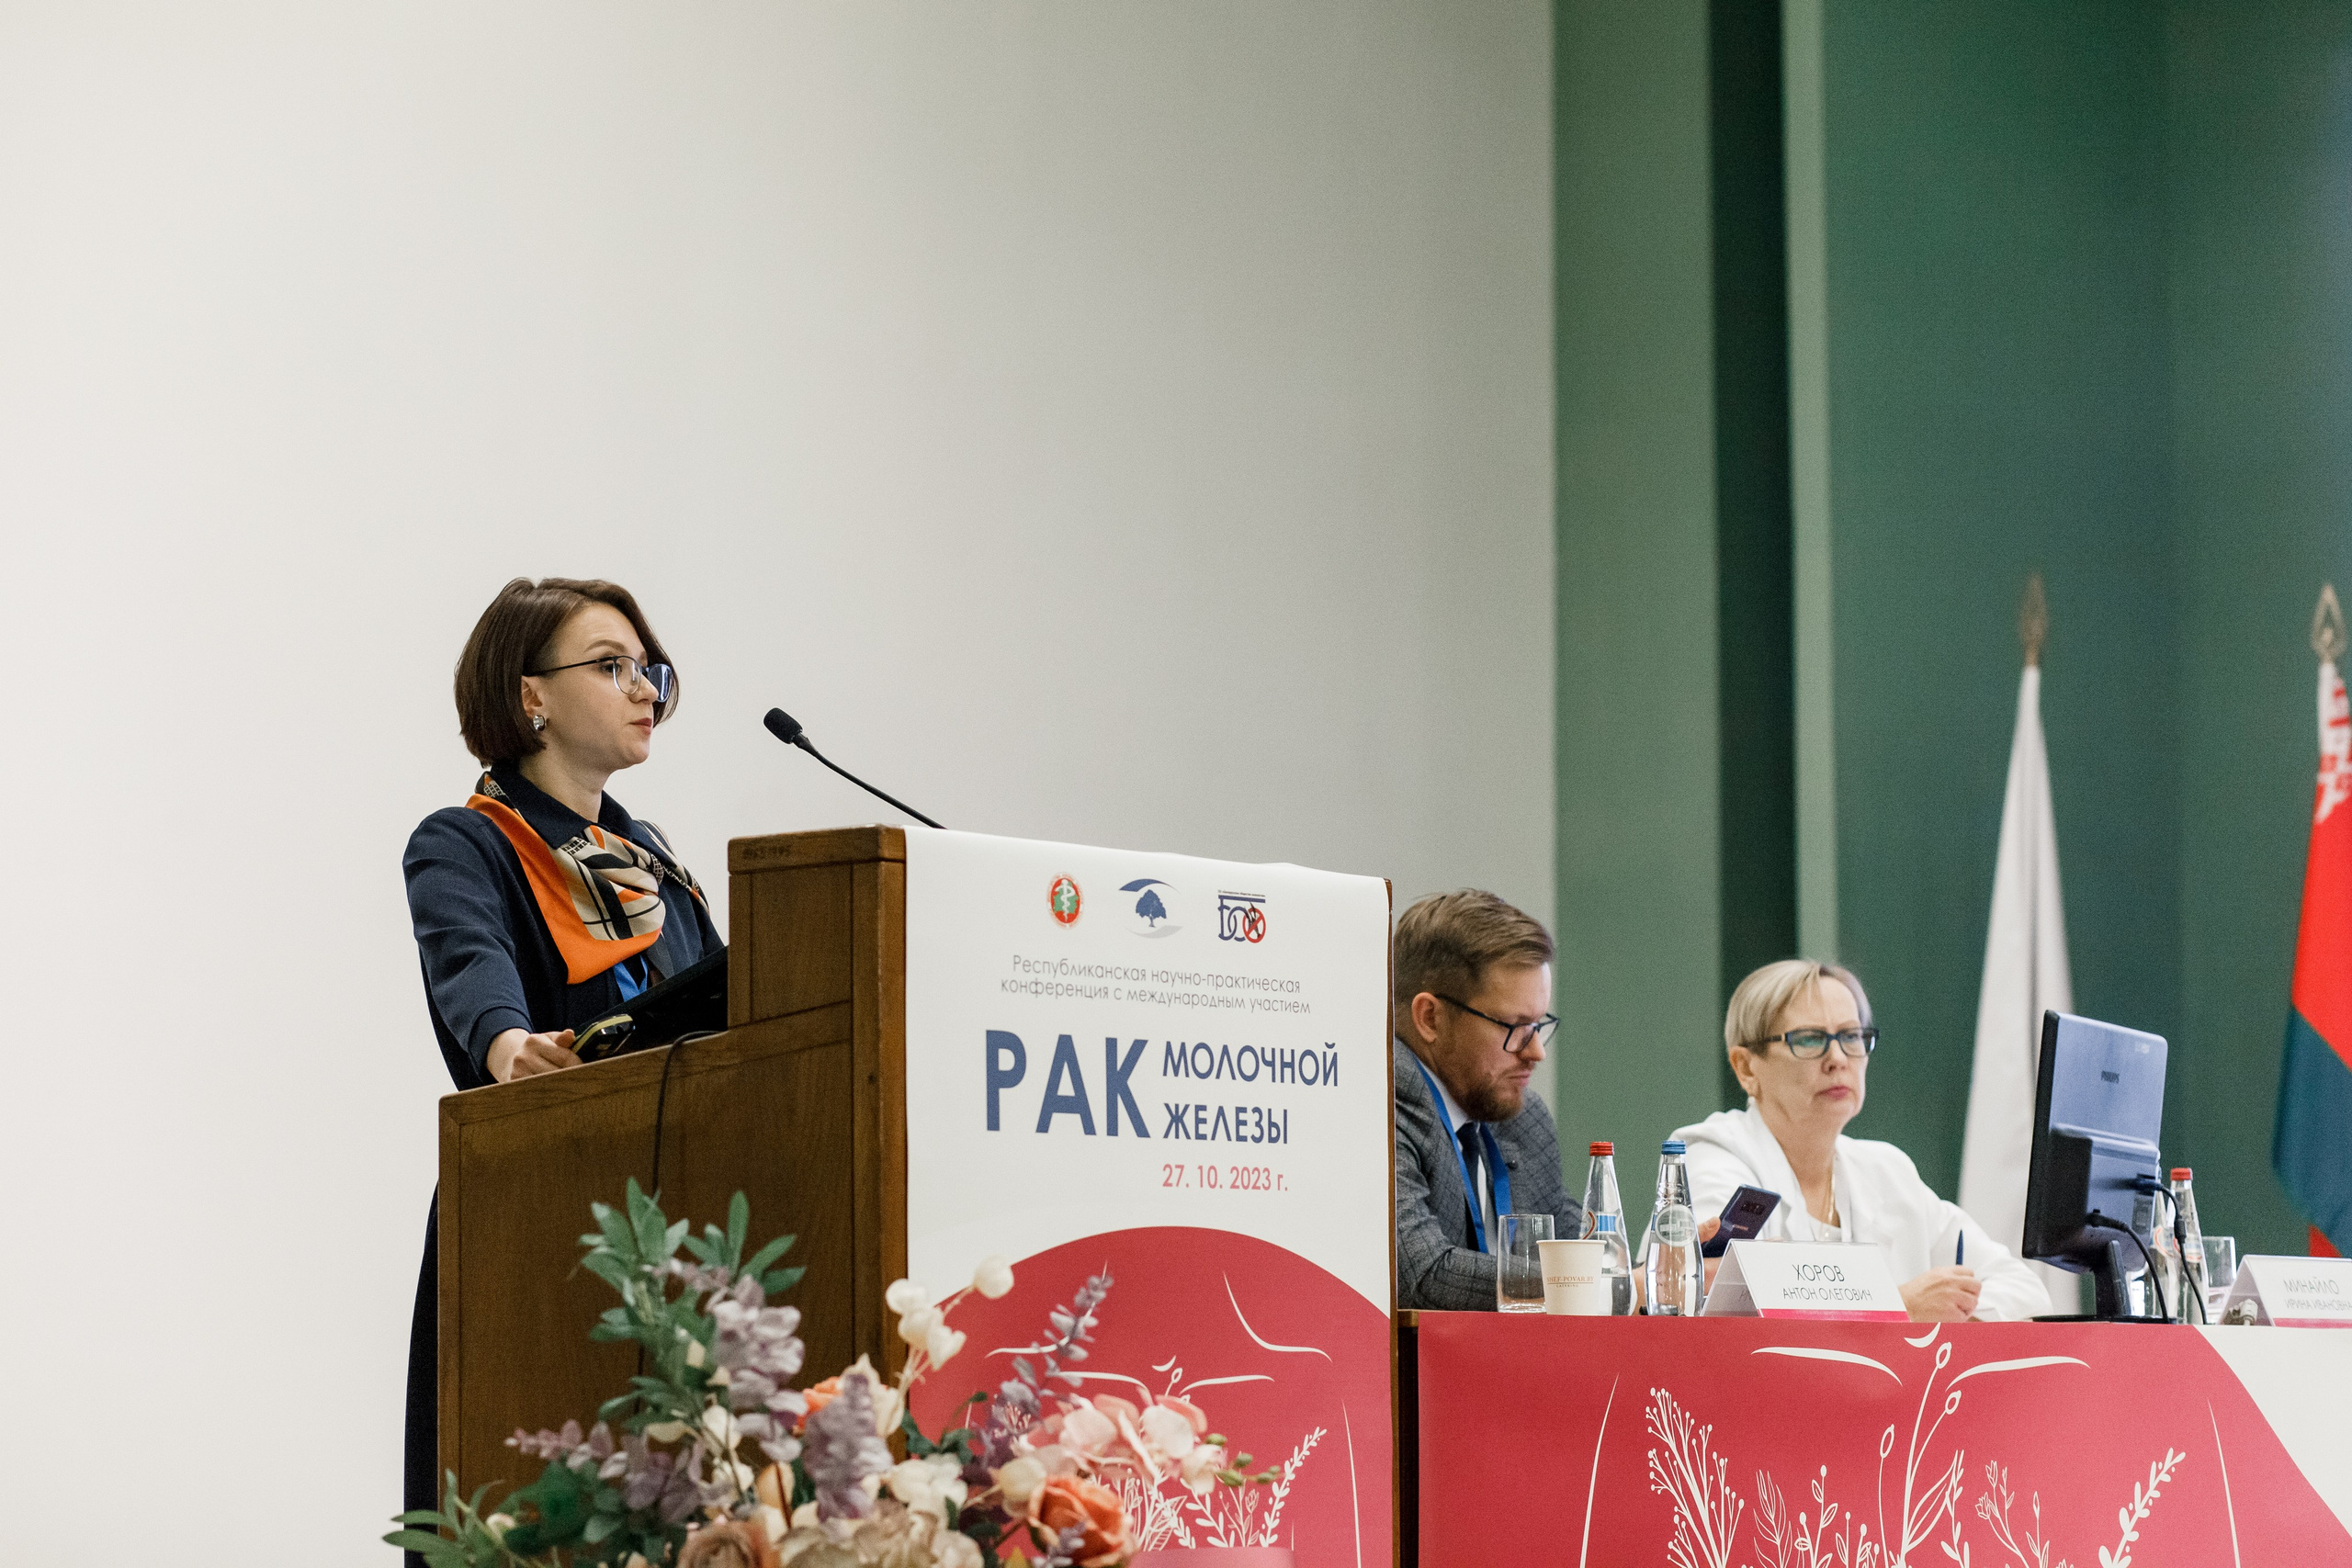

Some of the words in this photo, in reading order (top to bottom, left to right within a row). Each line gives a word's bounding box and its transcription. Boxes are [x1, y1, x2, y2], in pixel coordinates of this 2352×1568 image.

[1012, 954, 1147, 981] Республиканская
[1151, 969, 1300, 994] научно-практическая
[1001, 978, 1109, 999] конференция
[1114, 987, 1122, 1000] с
[1126, 989, 1246, 1009] международным
[1250, 998, 1311, 1014] участием
[1162, 1040, 1339, 1087] МОЛОЧНОЙ
[986, 1030, 1151, 1138] РАК
[1162, 1103, 1288, 1144] ЖЕЛЕЗЫ
[1162, 1164, 1189, 1189] 27.
[1197, 1165, 1223, 1190] 10.
[1229, 1166, 1272, 1190] 2023
[1277, 1173, 1288, 1191] г.
[1792, 1264, 1845, 1282] ХОРОВ
[1782, 1287, 1817, 1301] АНТОН
[1818, 1288, 1873, 1301] ОЛЕГОВИЧ
